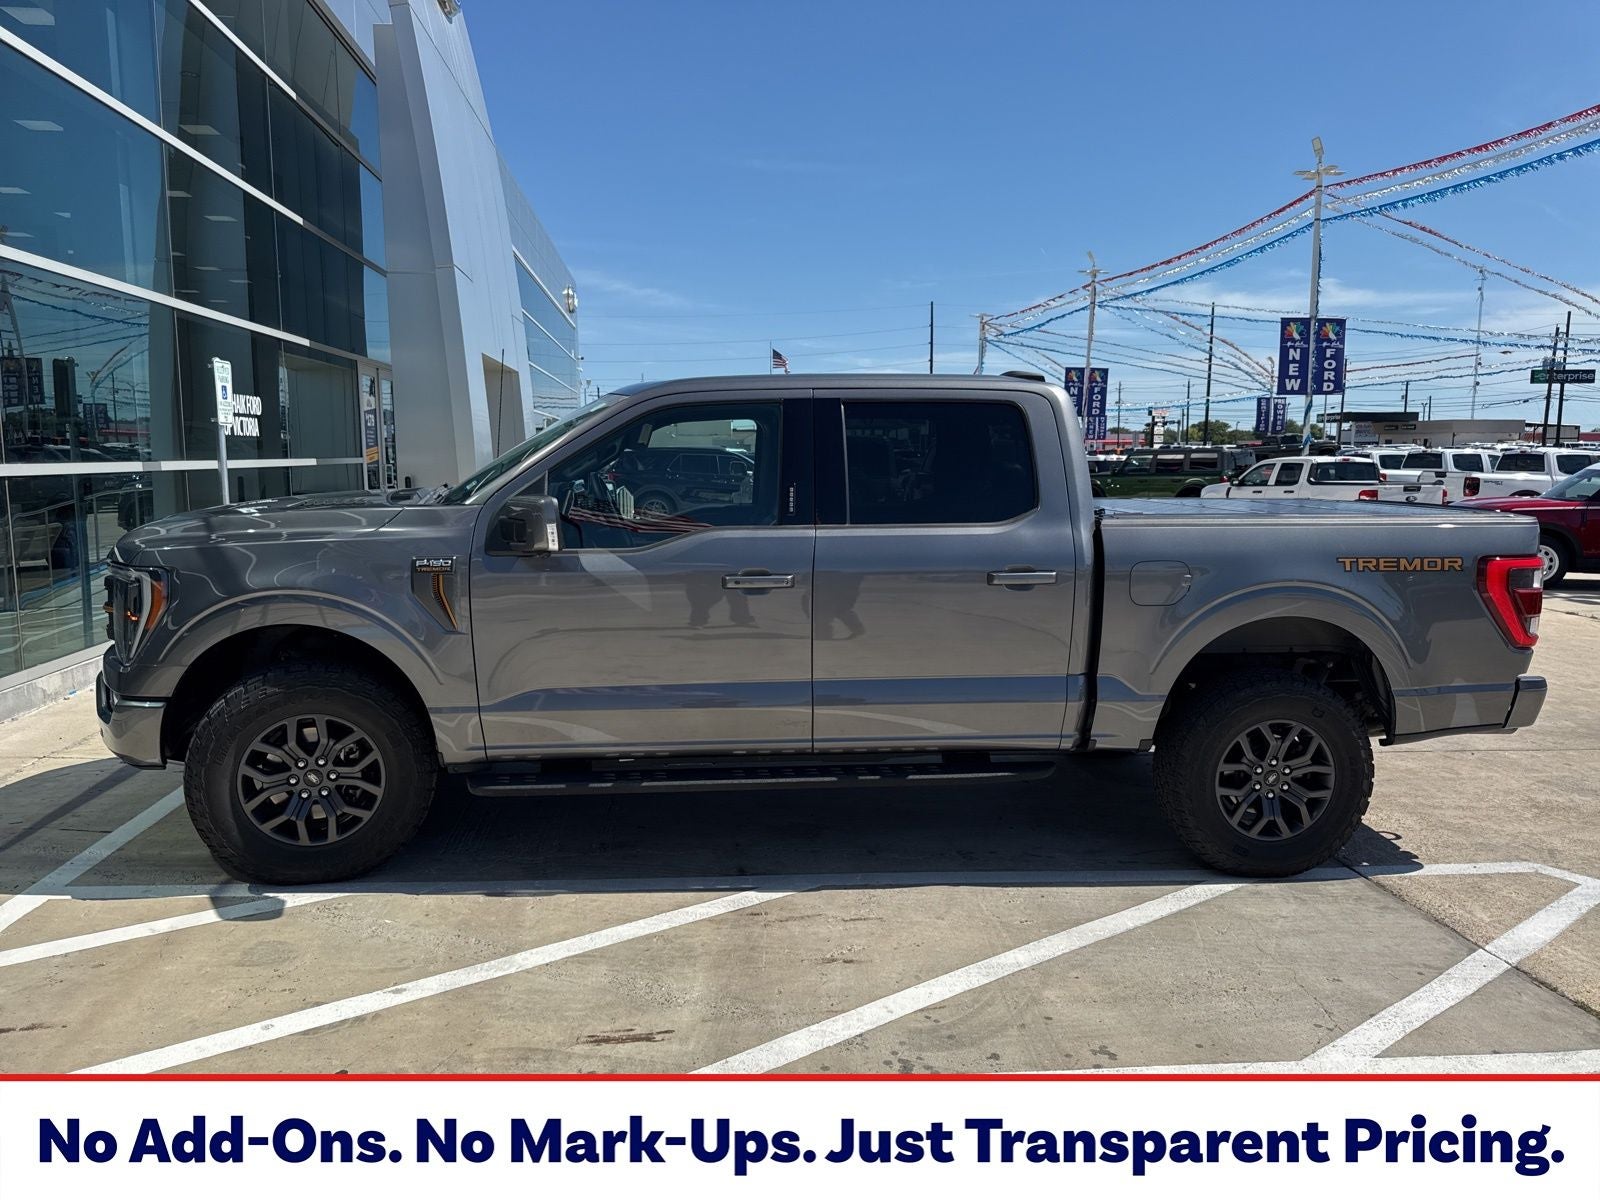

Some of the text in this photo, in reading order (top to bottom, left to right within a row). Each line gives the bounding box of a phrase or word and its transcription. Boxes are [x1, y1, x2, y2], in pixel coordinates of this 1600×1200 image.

[1285, 349, 1301, 390] NEW
[1323, 349, 1336, 391] FORD
[246, 396, 262, 415] FORD
[1092, 387, 1101, 415] FORD
[232, 417, 260, 437] VICTORIA
[415, 559, 452, 567] F-150
[1338, 557, 1464, 572] TREMOR
